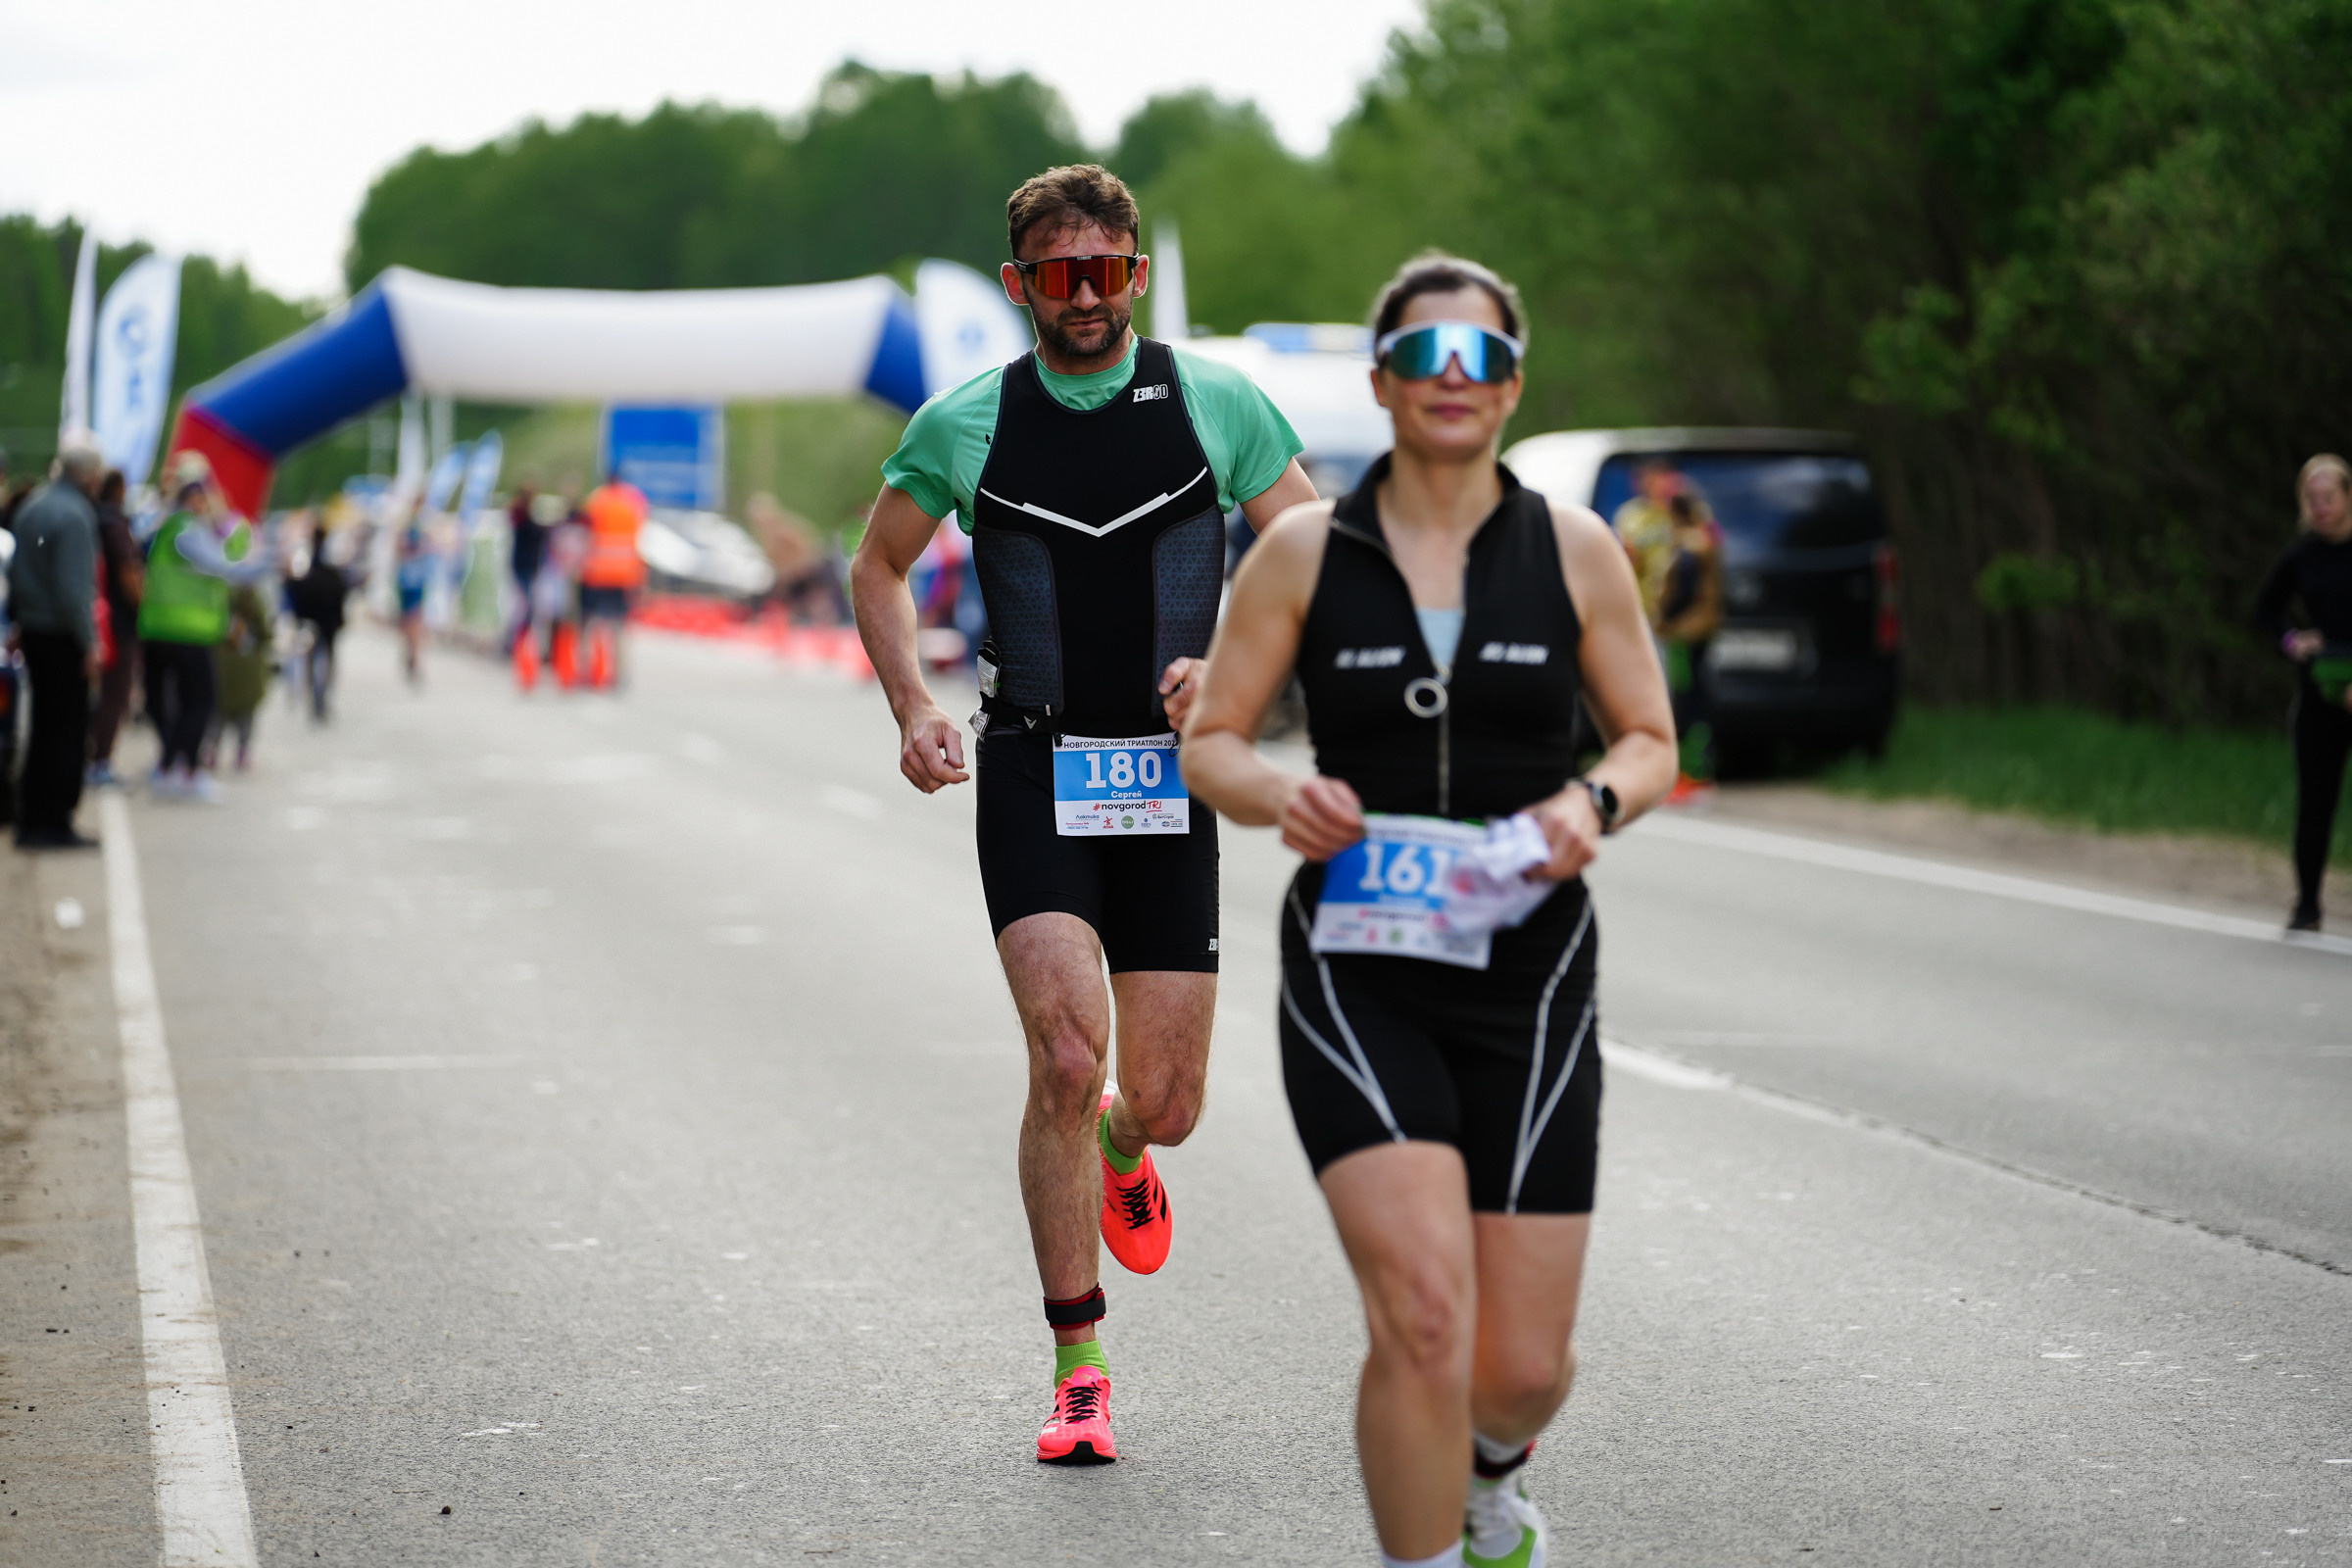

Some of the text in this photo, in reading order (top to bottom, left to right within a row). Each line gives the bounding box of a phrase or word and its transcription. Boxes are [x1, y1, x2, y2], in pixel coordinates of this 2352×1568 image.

[1063, 739, 1126, 749] НОВГОРОДСКИЙ
[1128, 739, 1163, 748] ТРИАТЛОН
[1085, 751, 1162, 789] 180
[1110, 790, 1143, 800] Сергей
[1358, 843, 1452, 897] 161
